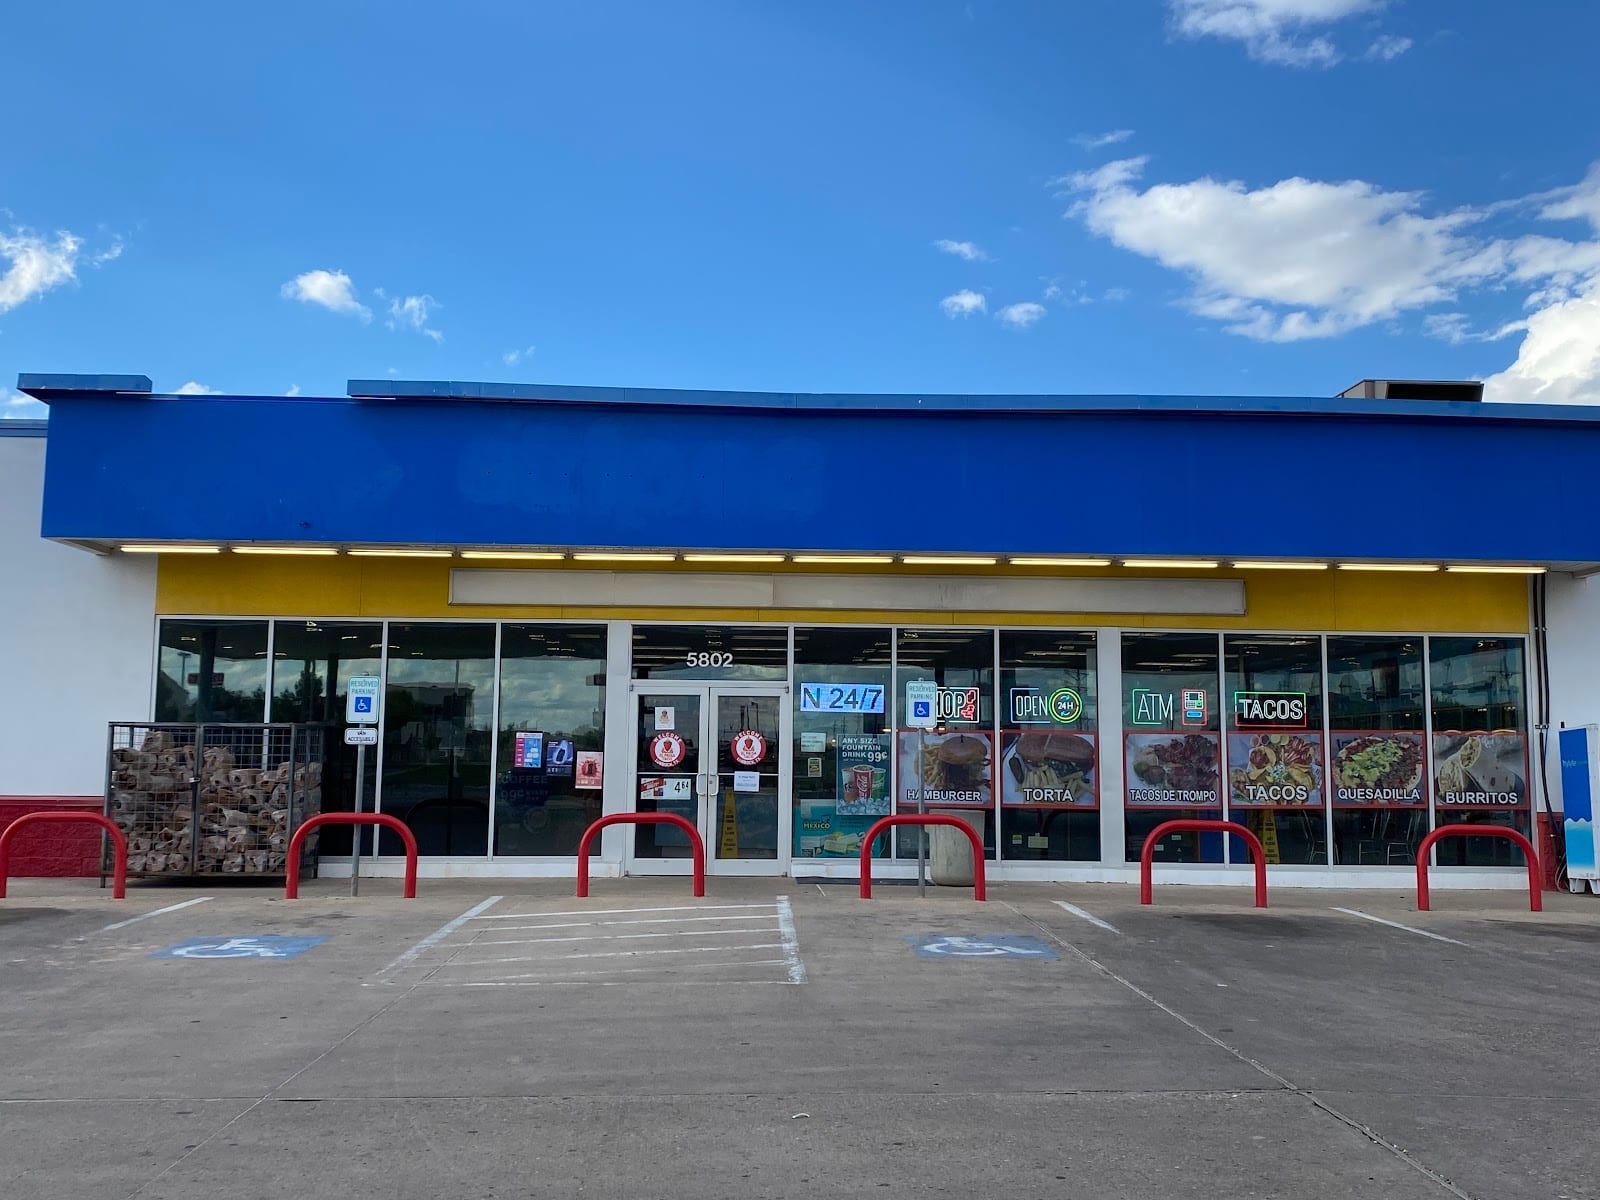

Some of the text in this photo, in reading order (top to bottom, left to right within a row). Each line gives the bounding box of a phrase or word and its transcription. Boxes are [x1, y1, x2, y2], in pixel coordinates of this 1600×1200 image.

[686, 652, 733, 667] 5802
[350, 680, 378, 688] RESERVED
[909, 685, 935, 693] RESERVED
[803, 687, 882, 710] N 24/7
[1015, 695, 1048, 717] OPEN
[1057, 702, 1074, 710] 24H
[1137, 693, 1173, 721] ATM
[1238, 699, 1303, 720] TACOS
[653, 732, 683, 743] WELCOME
[734, 730, 763, 741] WELCOME
[1023, 788, 1074, 802] TORTA
[1130, 789, 1217, 802] TACOS DE TROMPO
[1245, 785, 1308, 800] TACOS
[1338, 788, 1421, 801] QUESADILLA
[1446, 792, 1518, 804] BURRITOS
